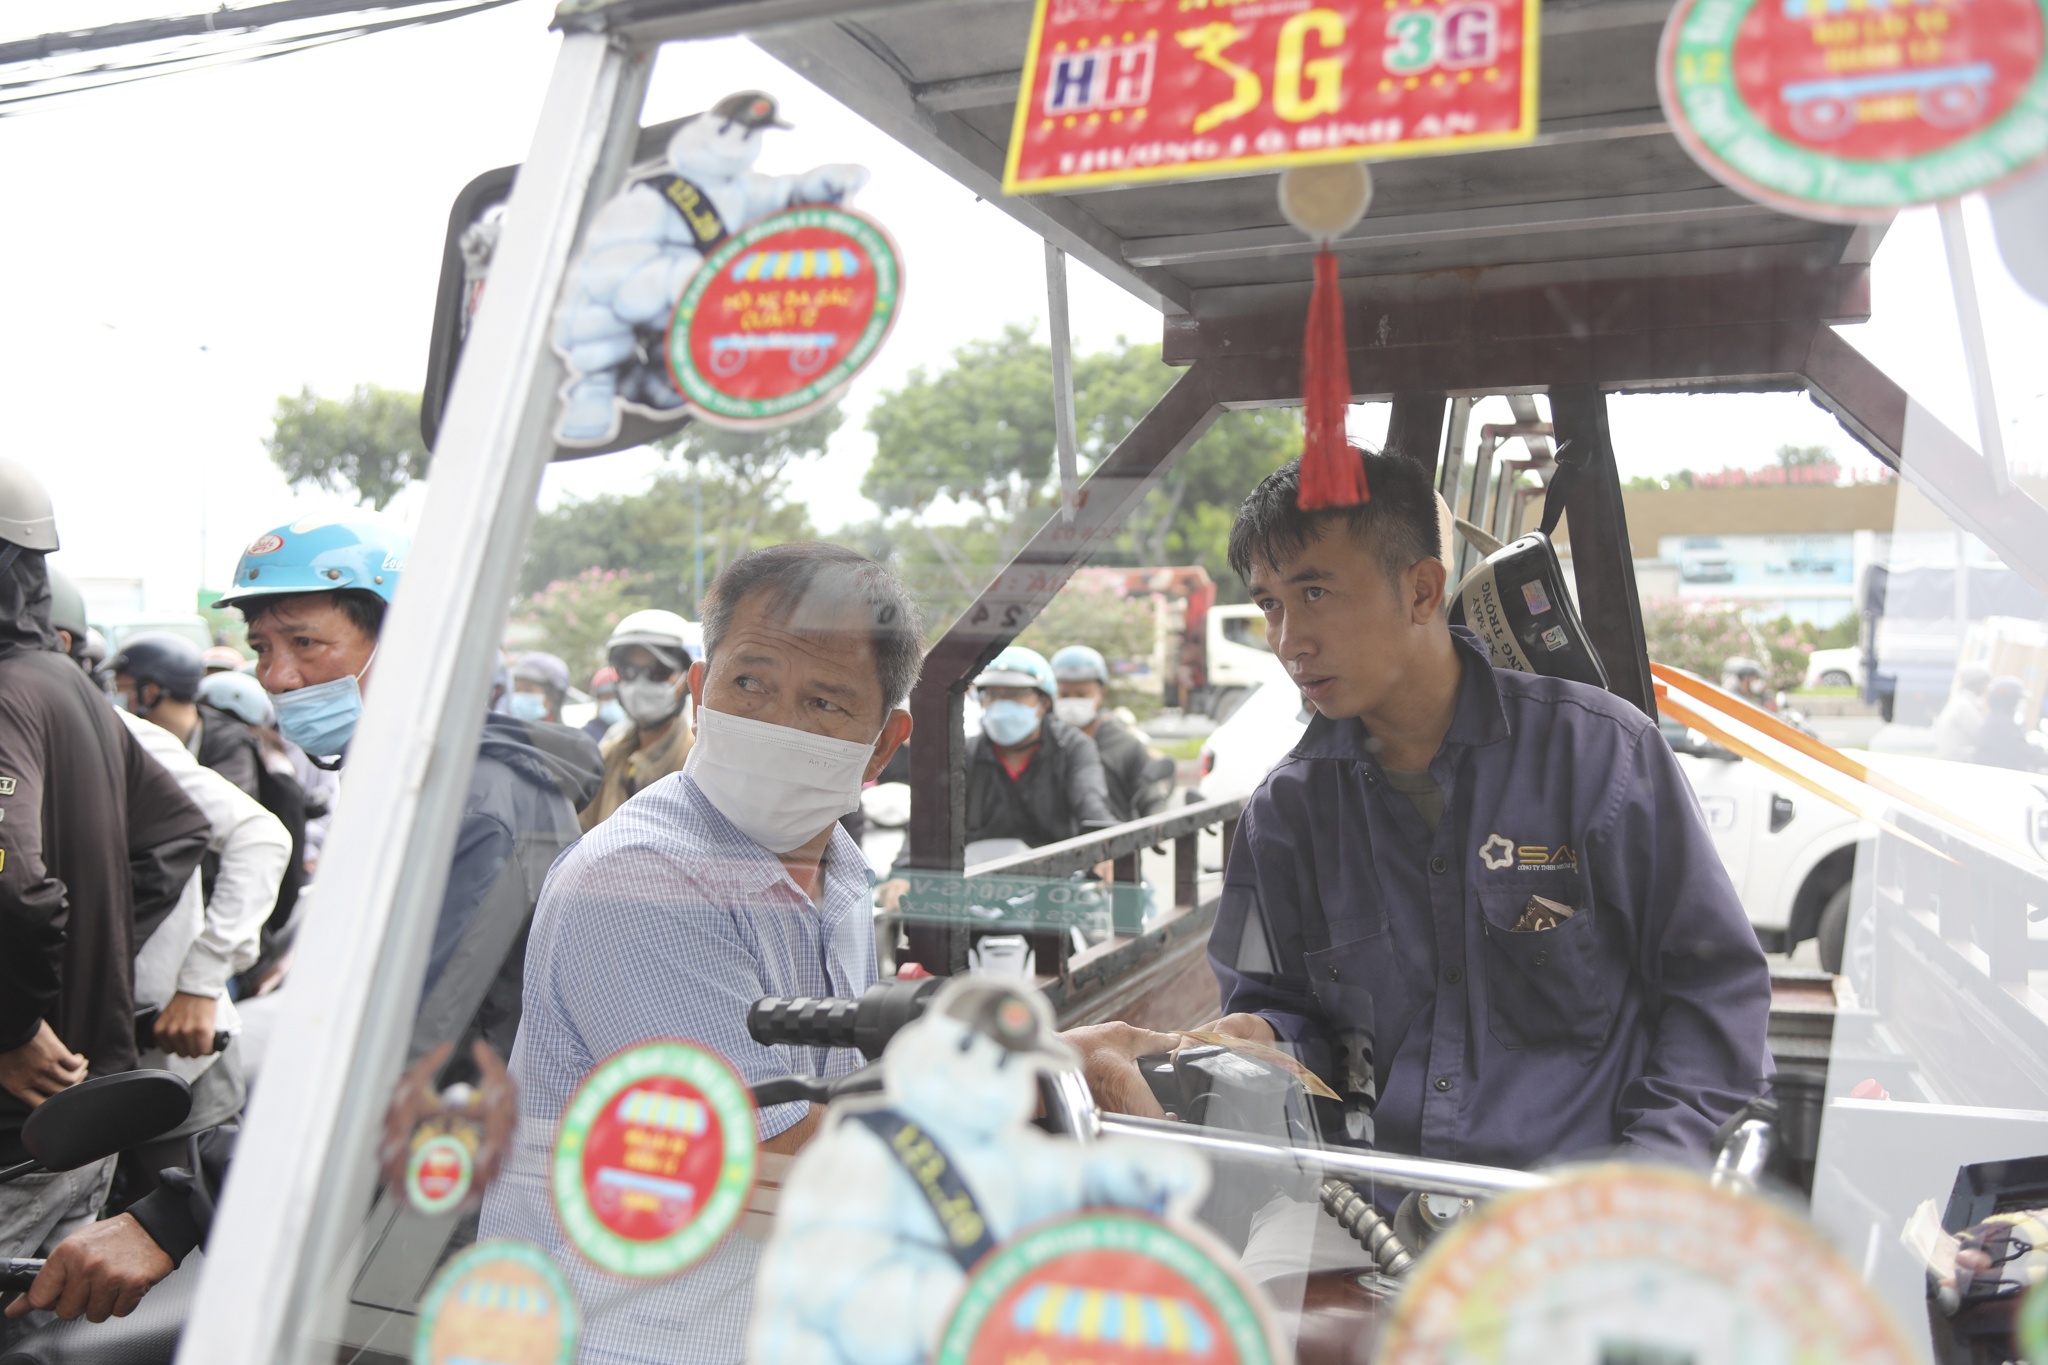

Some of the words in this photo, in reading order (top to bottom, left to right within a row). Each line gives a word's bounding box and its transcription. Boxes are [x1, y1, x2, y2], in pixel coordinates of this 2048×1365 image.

[1385, 5, 1499, 73] 3G
[1045, 40, 1157, 115] HH
[1175, 10, 1346, 134] 3G
[1481, 581, 1504, 639] TRỌNG
[1483, 633, 1498, 656] XE
[1501, 642, 1525, 672] NG
